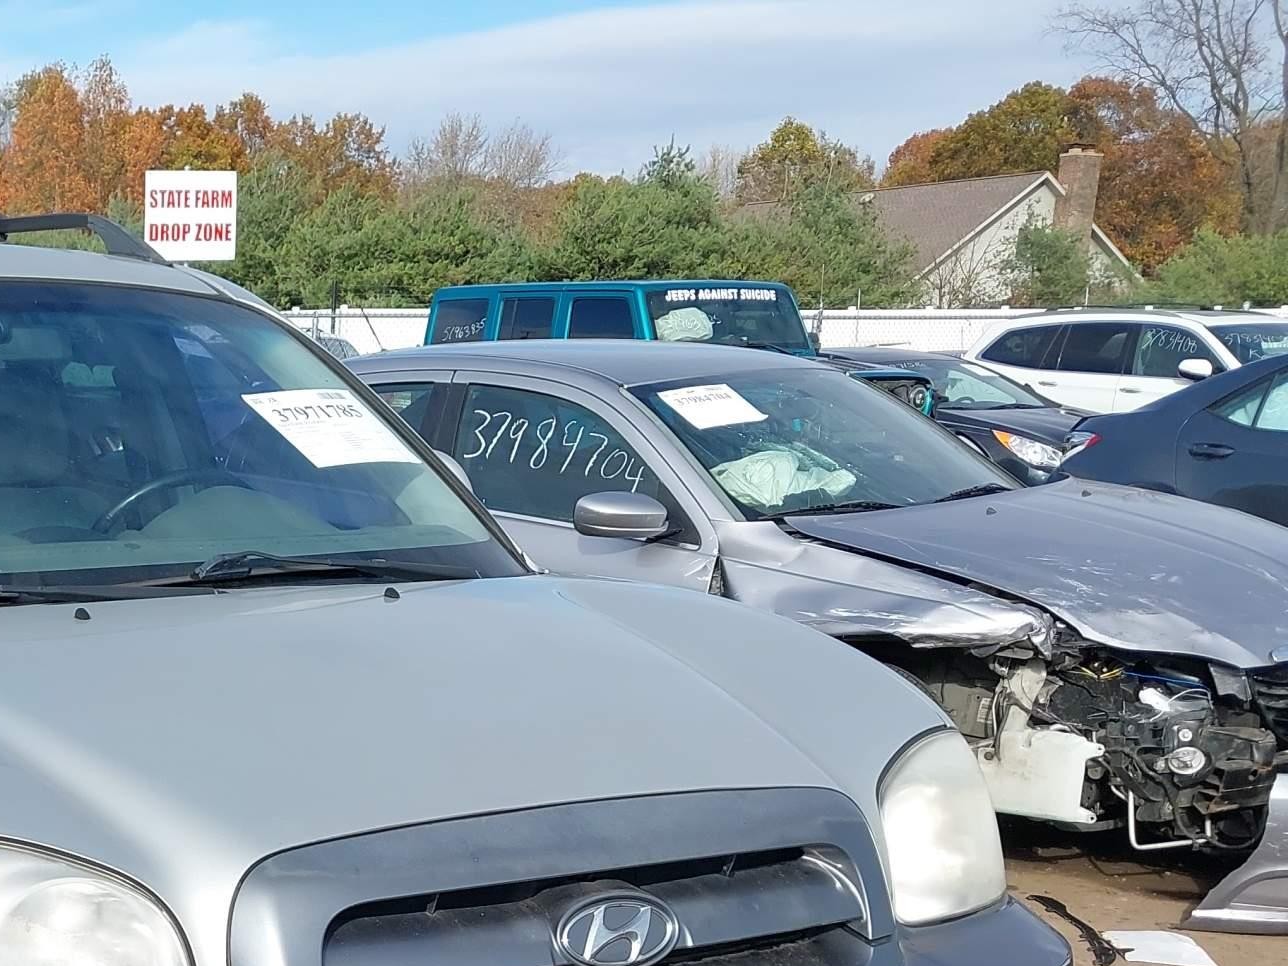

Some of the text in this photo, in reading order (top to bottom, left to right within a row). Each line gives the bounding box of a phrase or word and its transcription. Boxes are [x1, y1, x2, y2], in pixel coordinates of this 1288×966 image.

[149, 189, 232, 208] STATE FARM
[149, 223, 232, 241] DROP ZONE
[665, 288, 777, 301] JEEPS AGAINST SUICIDE
[272, 404, 363, 422] 37971785
[464, 409, 648, 493] 37984704
